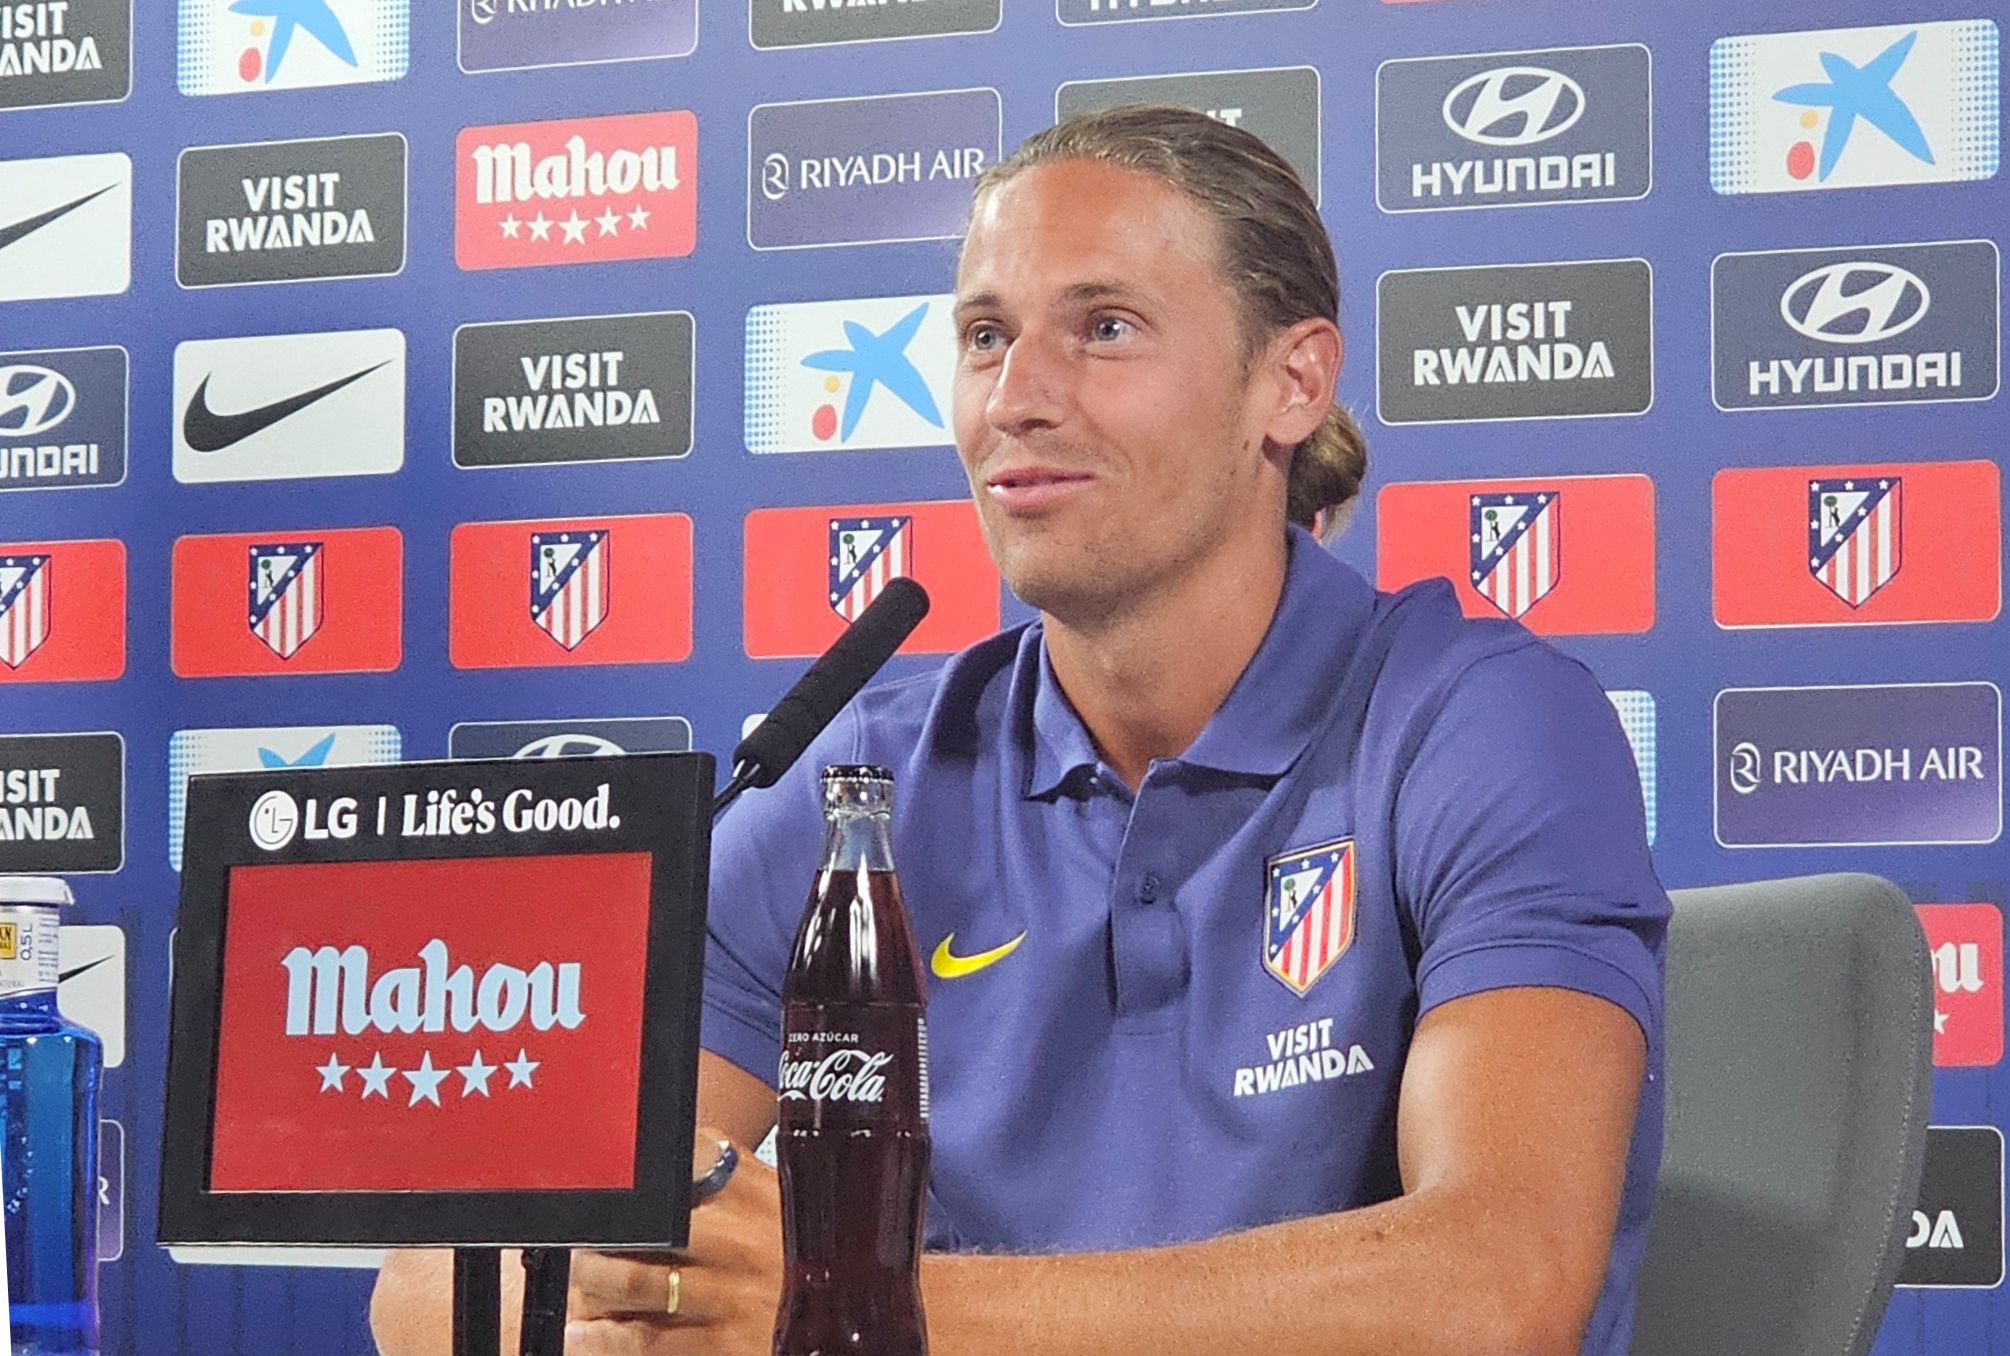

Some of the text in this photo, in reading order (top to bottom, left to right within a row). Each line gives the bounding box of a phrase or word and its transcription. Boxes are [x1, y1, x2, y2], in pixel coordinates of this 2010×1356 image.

[0, 2, 69, 39] ISIT
[0, 36, 103, 77] ANDA
[471, 136, 680, 204] Mahou
[801, 148, 985, 189] RIYADH AIR
[1412, 153, 1615, 197] HYUNDAI
[242, 173, 340, 212] VISIT
[206, 209, 375, 253] RWANDA
[1455, 301, 1572, 342] VISIT
[520, 352, 624, 391] VISIT
[1413, 342, 1615, 386] RWANDA
[1749, 352, 1961, 395] HYUNDAI
[483, 389, 661, 433] RWANDA
[0, 443, 98, 478] NDAI
[0, 769, 60, 803] SIT
[1774, 747, 1985, 784] RIYADH AIR
[0, 806, 94, 841] ANDA
[304, 783, 621, 839] LG Life's Good.
[281, 939, 587, 1036] Mahou
[788, 1031, 859, 1043] ZERO AZÚCAR
[1266, 1019, 1333, 1061] VISIT
[1233, 1044, 1374, 1097] RWANDA
